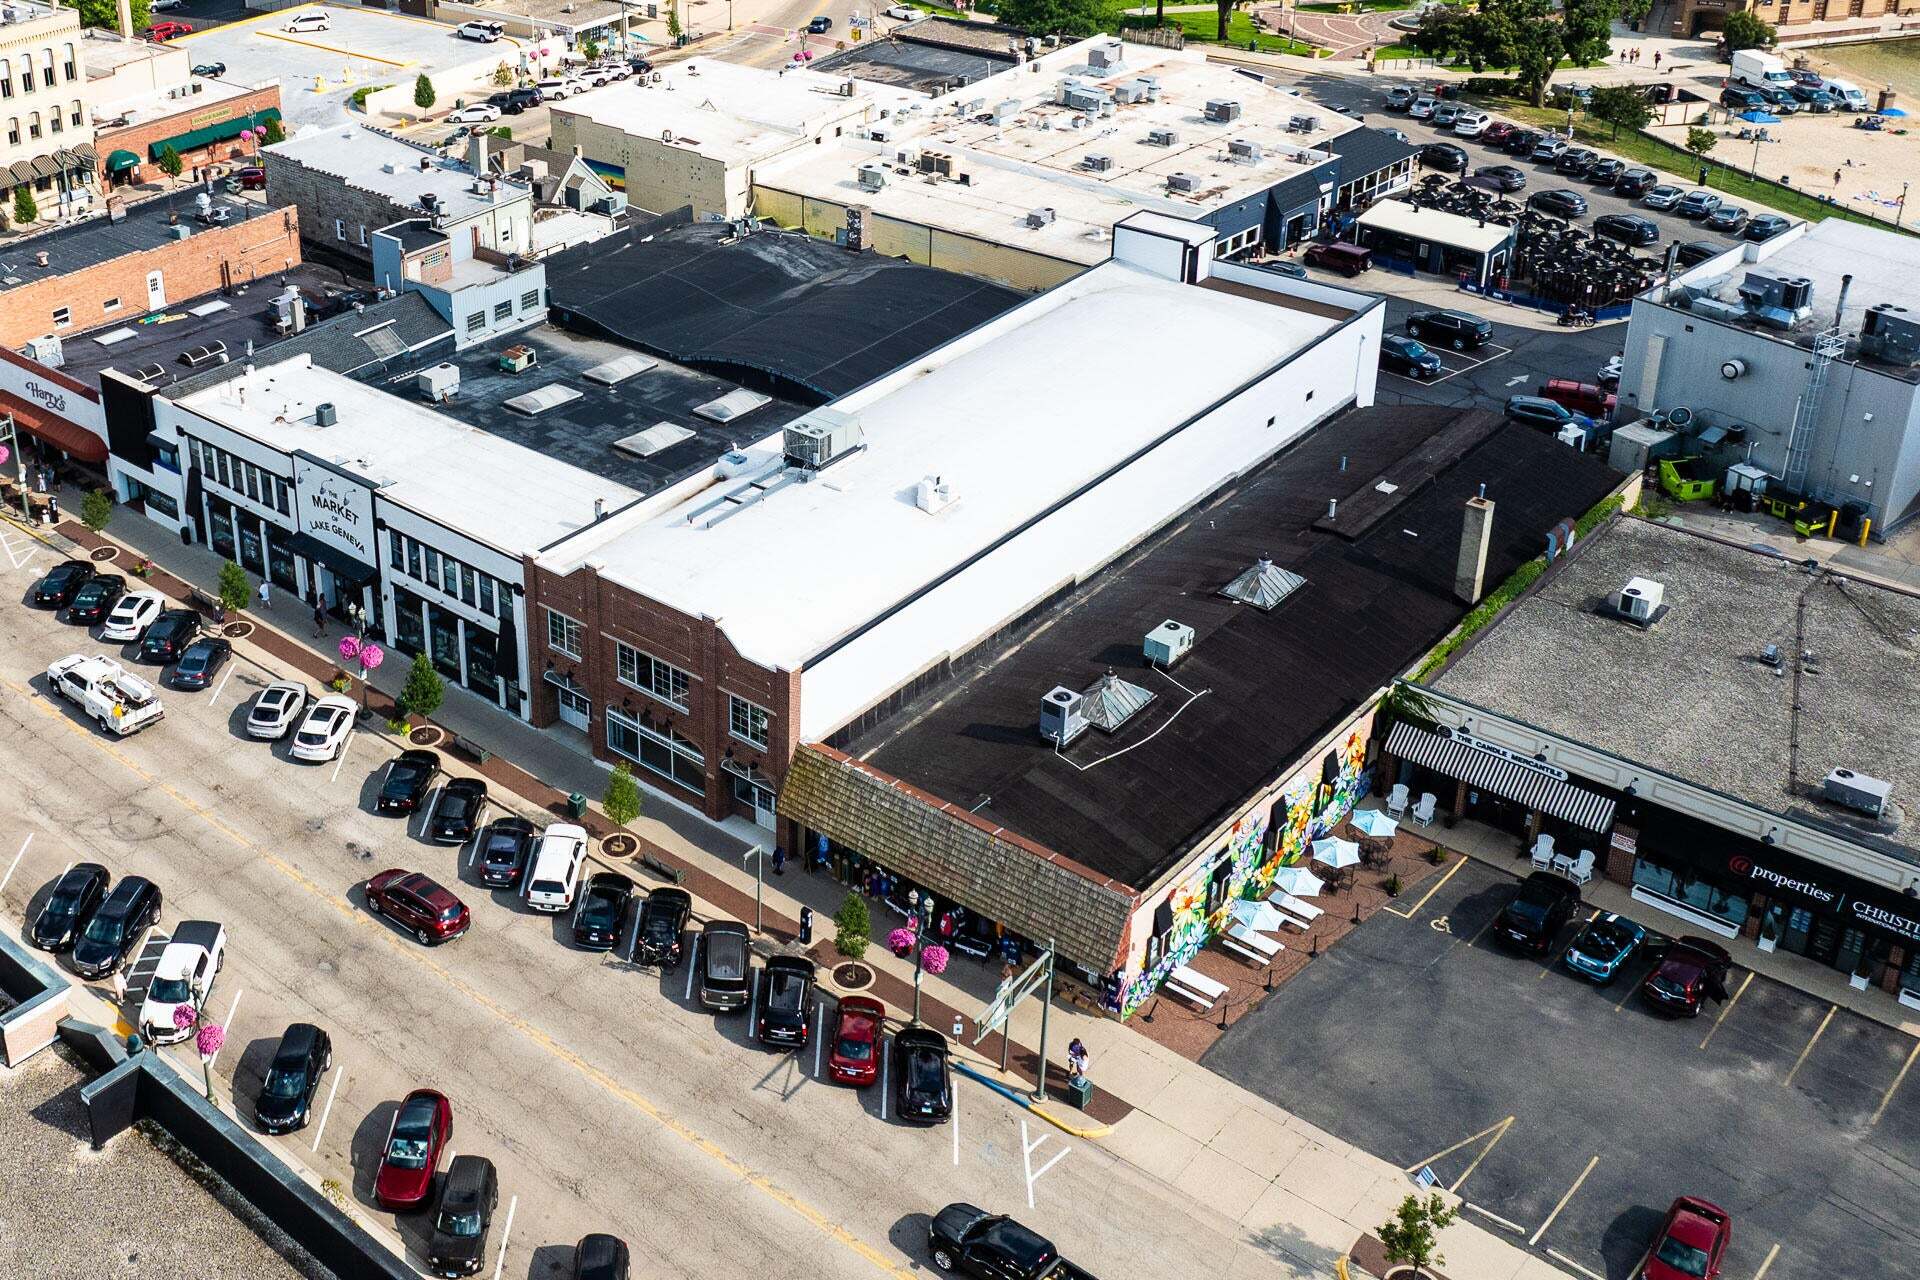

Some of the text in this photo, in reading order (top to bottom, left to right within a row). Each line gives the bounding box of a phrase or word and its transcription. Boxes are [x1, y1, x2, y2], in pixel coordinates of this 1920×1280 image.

[25, 381, 67, 411] Harry's
[328, 490, 338, 499] THE
[311, 495, 360, 526] MARKET
[310, 520, 366, 555] LAKE GENEVA
[1457, 733, 1563, 778] THE CANDLE MERCANTILE
